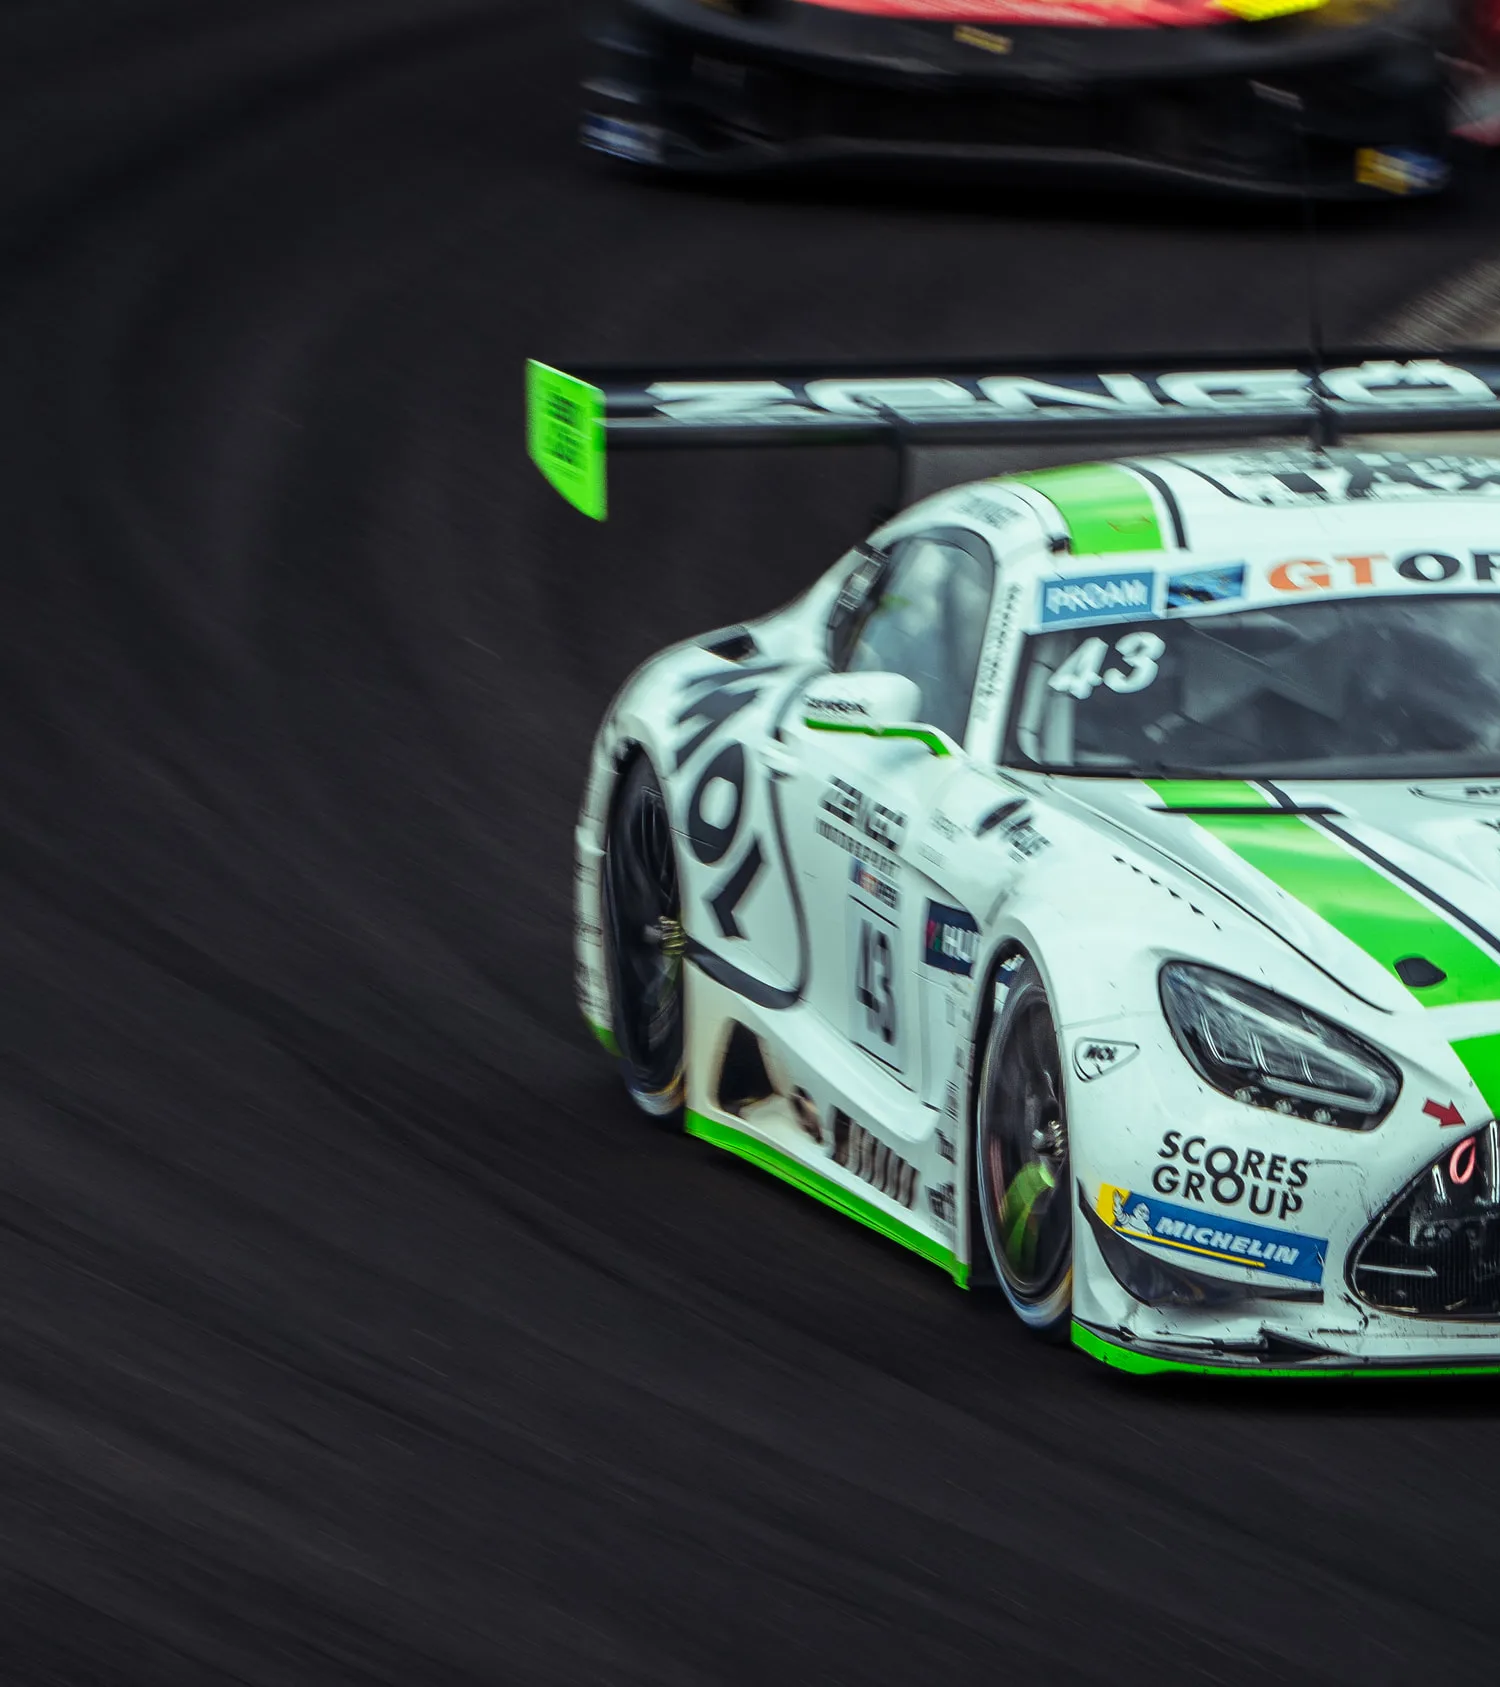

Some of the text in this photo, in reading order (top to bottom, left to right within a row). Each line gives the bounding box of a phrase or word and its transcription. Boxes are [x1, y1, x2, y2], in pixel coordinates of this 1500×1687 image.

[1048, 631, 1166, 699] 43
[1156, 1129, 1309, 1188] SCORES
[1152, 1163, 1304, 1222] GROUP
[1156, 1216, 1300, 1266] MICHELIN
